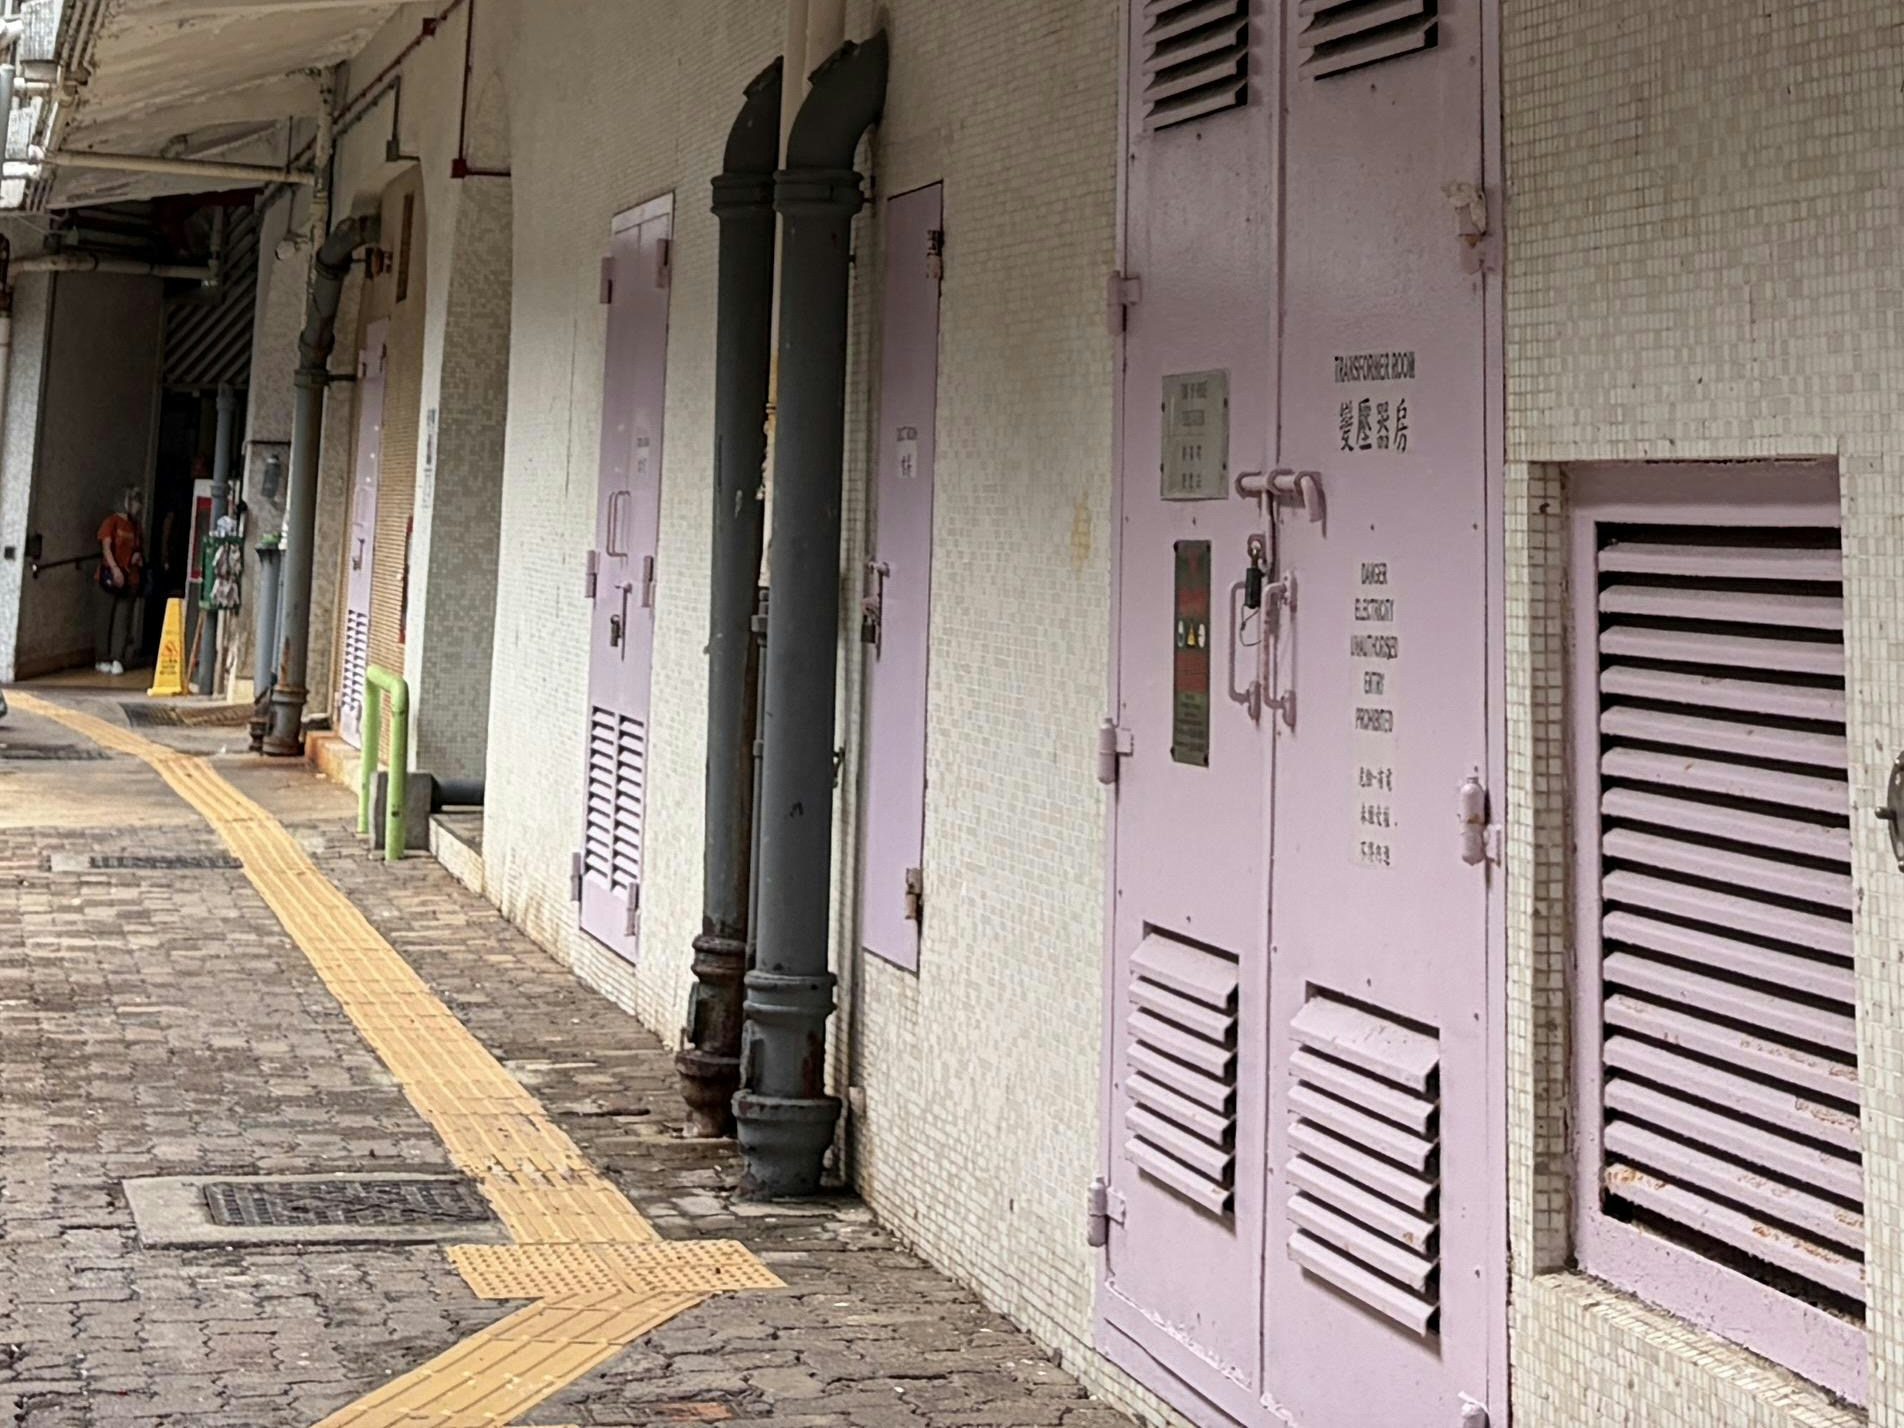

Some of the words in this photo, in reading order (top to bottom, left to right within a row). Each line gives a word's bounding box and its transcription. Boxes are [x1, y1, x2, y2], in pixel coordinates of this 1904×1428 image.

[1334, 352, 1390, 383] TRANSFORMER
[1391, 351, 1416, 380] ROOM
[1339, 397, 1409, 453] 變壓器房
[1361, 562, 1388, 585] DANGER
[1354, 597, 1395, 622] ELECTRICITY
[1363, 671, 1385, 695] ENTRY
